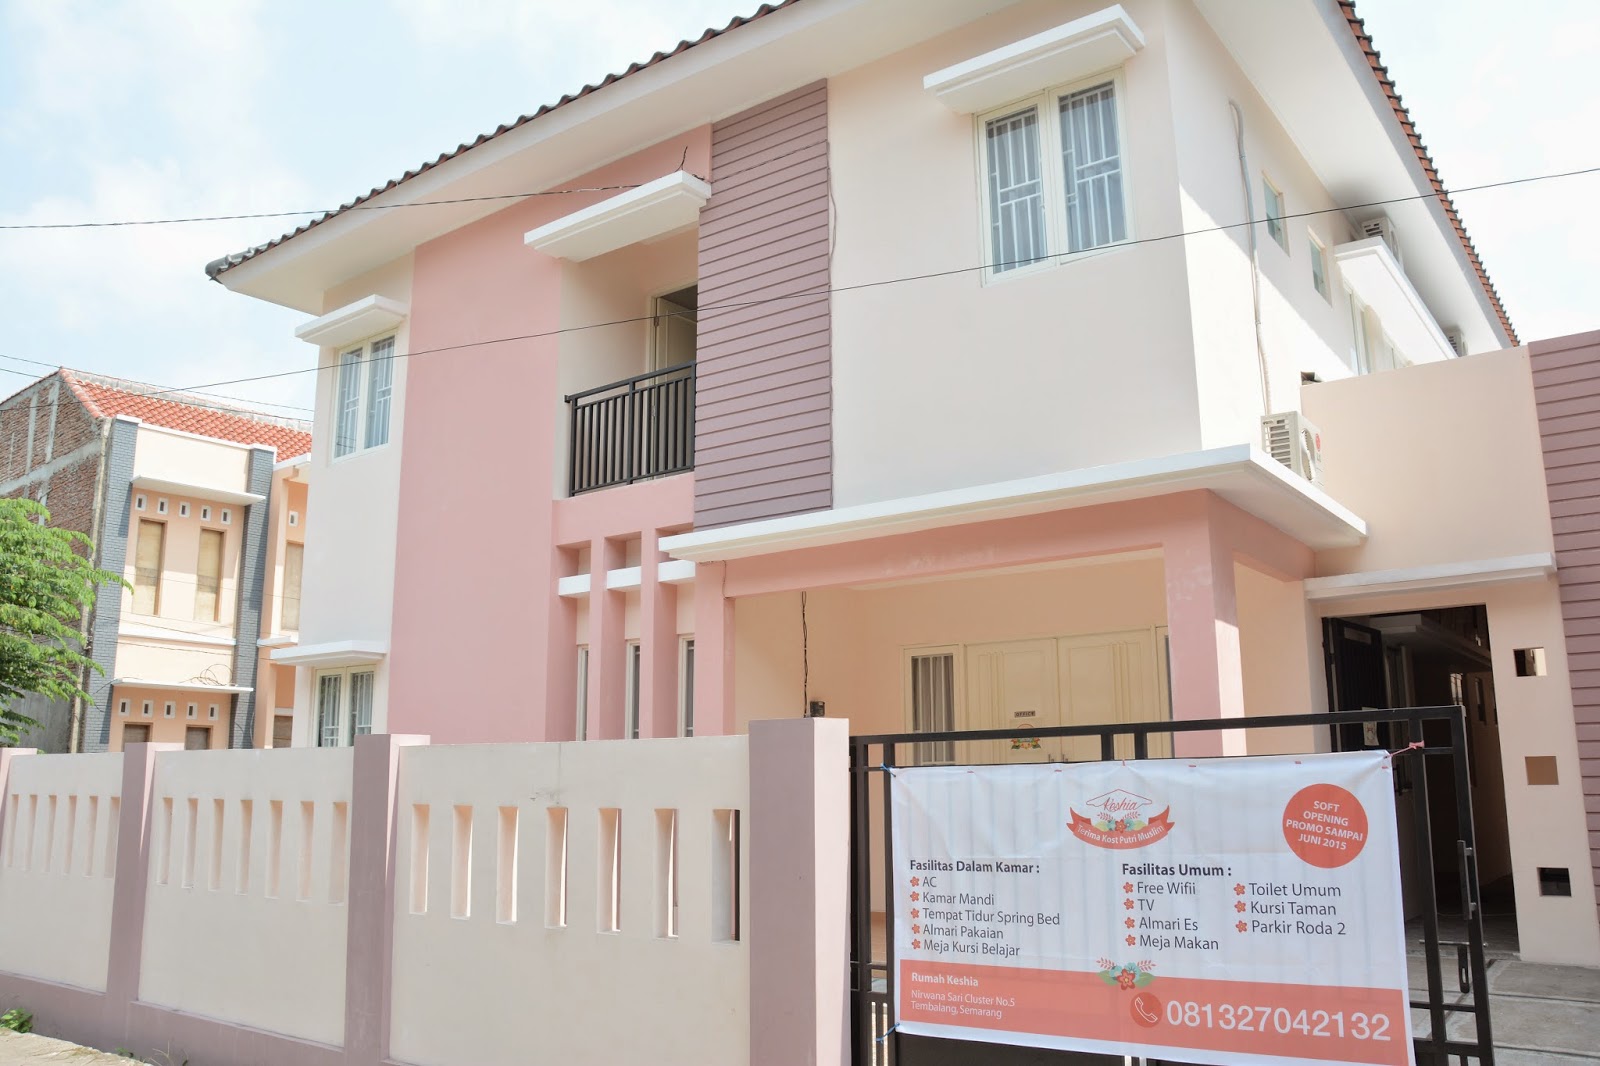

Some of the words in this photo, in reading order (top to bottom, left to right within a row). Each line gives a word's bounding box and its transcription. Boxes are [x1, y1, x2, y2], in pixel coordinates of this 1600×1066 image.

[1104, 797, 1138, 812] Keshia
[1314, 801, 1340, 812] SOFT
[1304, 811, 1348, 826] OPENING
[1077, 825, 1100, 840] Terima
[1120, 835, 1136, 843] Putri
[1138, 826, 1164, 841] Muslim
[1286, 819, 1323, 833] PROMO
[1325, 827, 1363, 841] SAMPAI
[1298, 834, 1320, 845] JUNI
[1323, 839, 1346, 850] 2015
[910, 860, 953, 871] Fasilitas
[957, 861, 992, 872] Dalam
[996, 862, 1033, 873] Kamar
[1122, 863, 1175, 875] Fasilitas
[1179, 864, 1224, 876] Umum
[923, 877, 936, 887] AC
[1137, 882, 1164, 894] Free
[1166, 882, 1196, 894] Wifii
[1249, 883, 1287, 896] Toilet
[1292, 884, 1341, 897] Umum
[923, 892, 956, 904] Kamar
[959, 894, 994, 905] Mandi
[1137, 899, 1154, 911] TV
[1251, 901, 1285, 914] Kursi
[1287, 902, 1336, 915] Taman
[923, 908, 962, 922] Tempat
[965, 910, 994, 922] Tidur
[998, 911, 1033, 927] Spring
[1037, 913, 1060, 925] Bed
[1139, 917, 1180, 930] Almari
[1184, 919, 1198, 930] Es
[923, 924, 957, 936] Almari
[961, 926, 1003, 939] Pakaian
[1252, 920, 1292, 933] Parkir
[1296, 921, 1333, 935] Roda
[1338, 922, 1346, 935] 2
[924, 940, 949, 954] Meja
[953, 941, 978, 953] Kursi
[982, 943, 1020, 958] Belajar
[1140, 935, 1170, 950] Meja
[1174, 936, 1218, 949] Makan
[911, 972, 944, 984] Rumah
[947, 975, 978, 987] Keshia
[911, 990, 945, 1000] Nirwana
[948, 992, 962, 1002] Sari
[965, 994, 993, 1004] Cluster
[996, 997, 1015, 1006] No.5
[911, 1001, 958, 1015] Tembalang,
[960, 1005, 1002, 1019] Semarang
[1166, 1000, 1391, 1041] 081327042132
